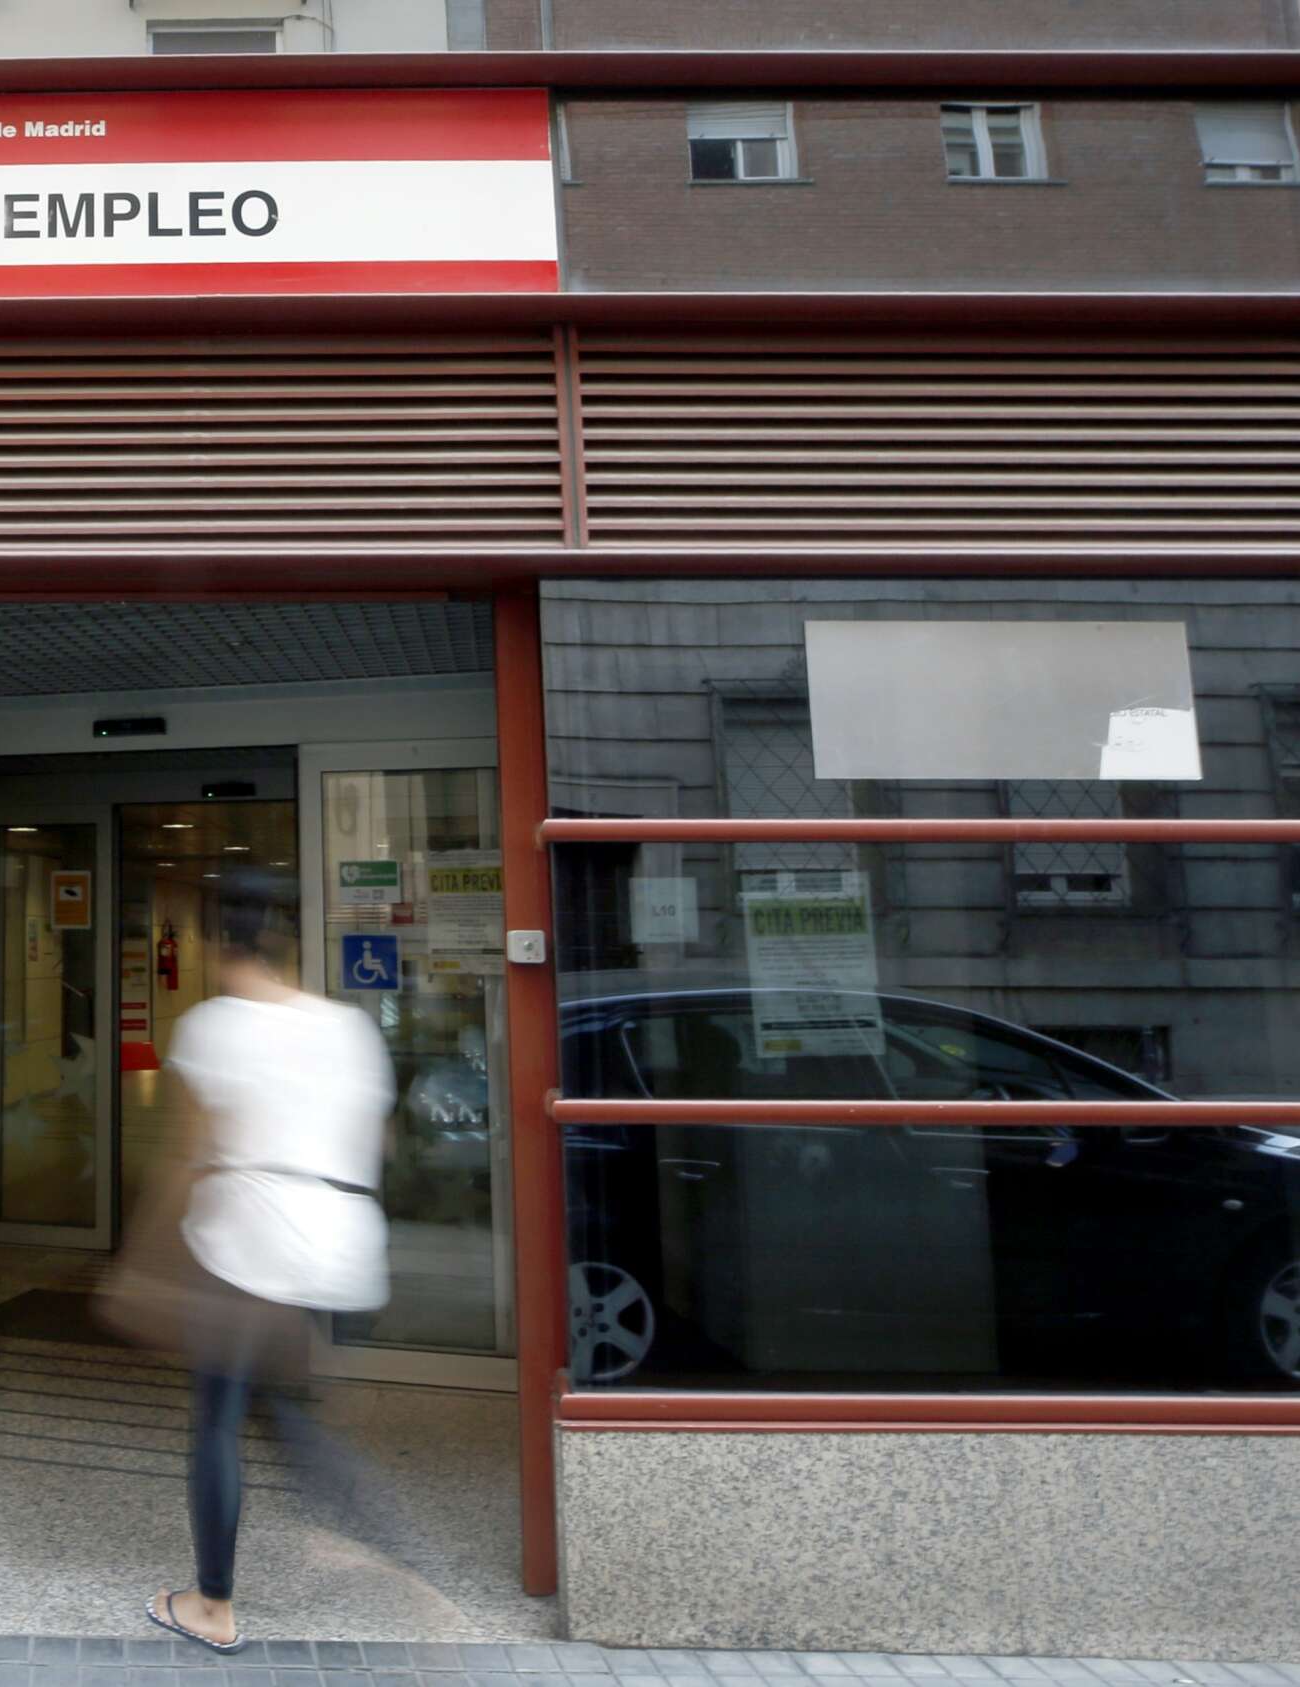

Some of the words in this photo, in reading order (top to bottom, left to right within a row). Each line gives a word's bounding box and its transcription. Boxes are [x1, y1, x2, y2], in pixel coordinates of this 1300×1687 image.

[24, 120, 107, 138] Madrid
[3, 189, 280, 239] EMPLEO
[431, 873, 459, 893] CITA
[753, 909, 795, 933] CITA
[799, 906, 864, 932] PREVIA
